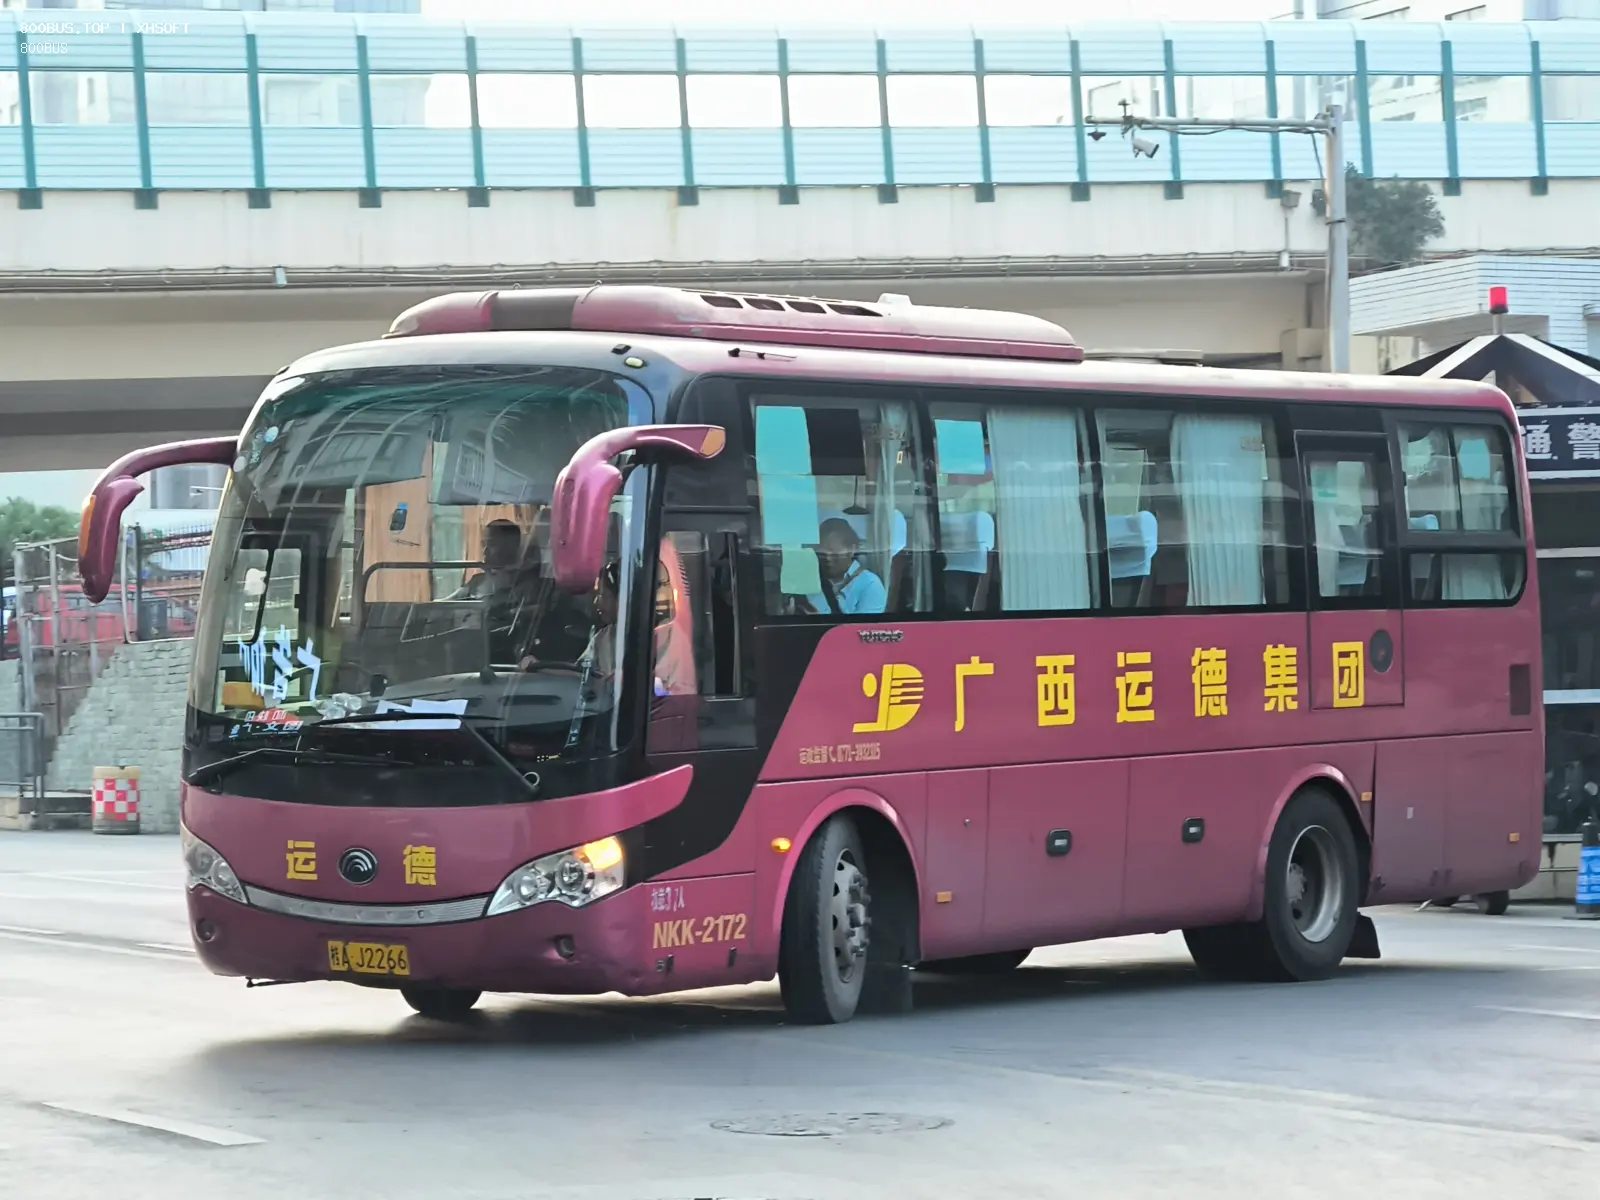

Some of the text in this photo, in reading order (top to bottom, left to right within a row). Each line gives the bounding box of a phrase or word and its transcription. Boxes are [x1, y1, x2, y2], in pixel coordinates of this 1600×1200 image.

[954, 641, 1365, 732] 广西运德集团
[285, 839, 437, 886] 运 德
[652, 913, 747, 949] NKK-2172
